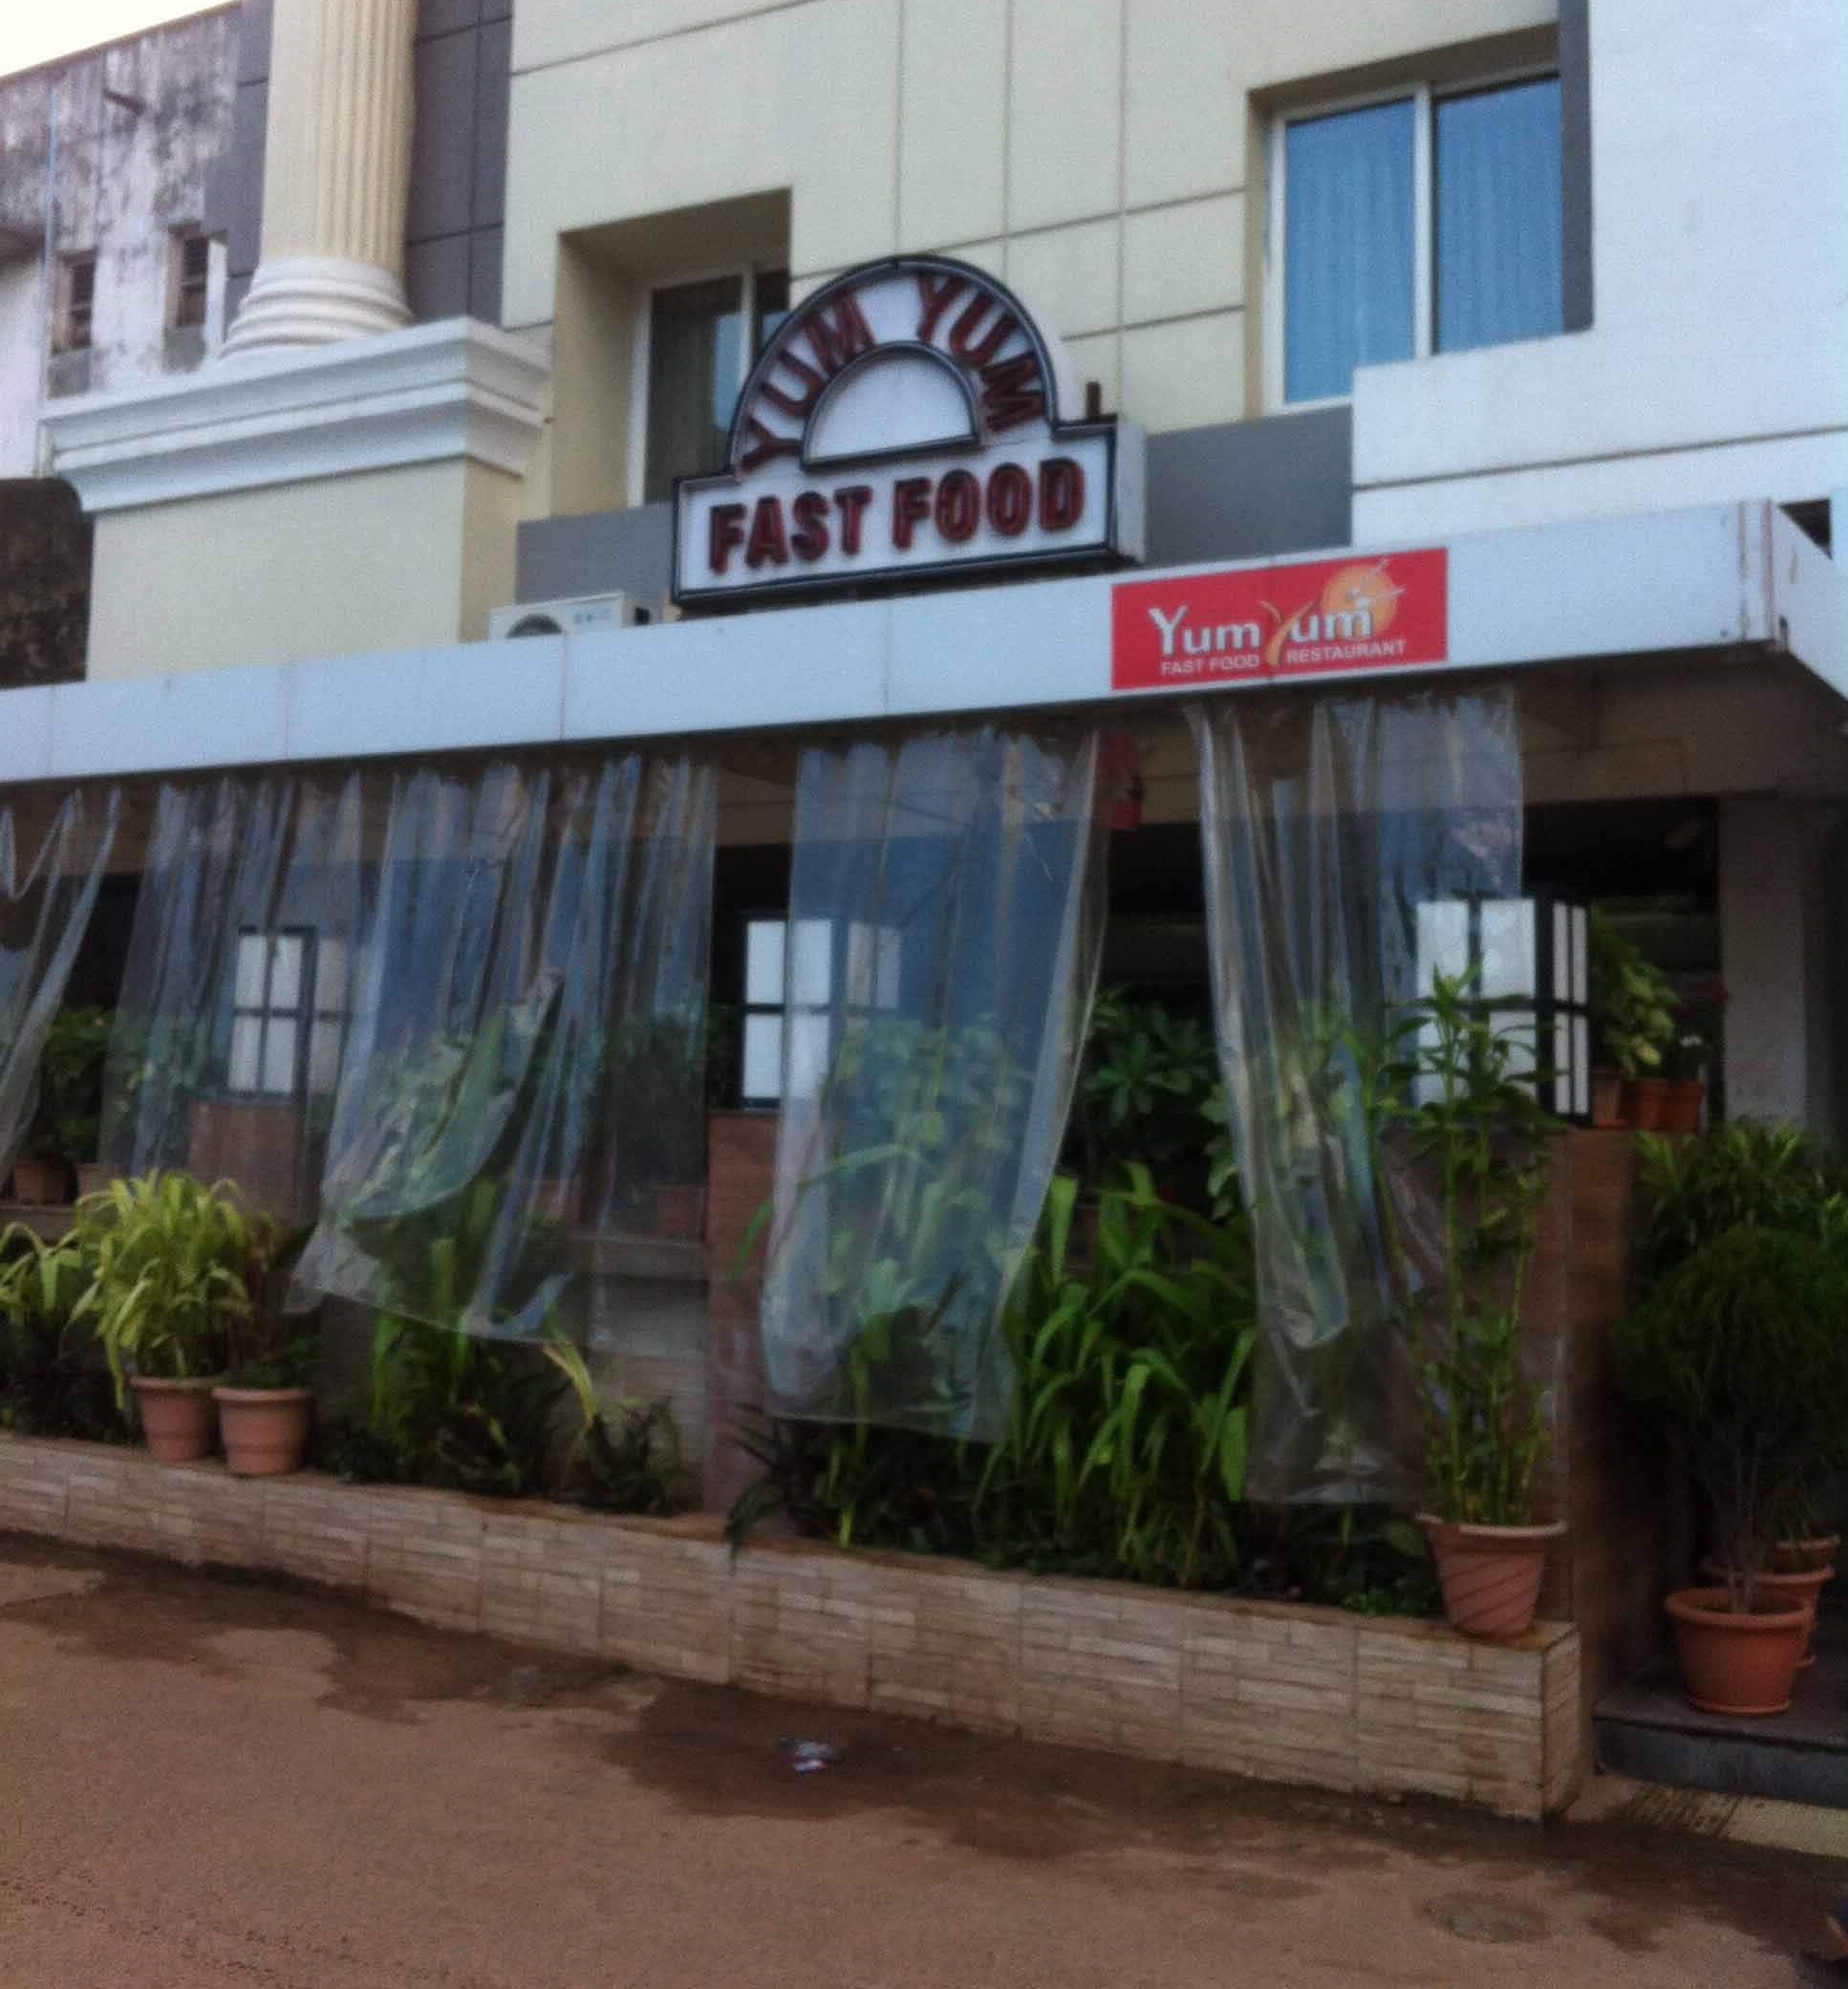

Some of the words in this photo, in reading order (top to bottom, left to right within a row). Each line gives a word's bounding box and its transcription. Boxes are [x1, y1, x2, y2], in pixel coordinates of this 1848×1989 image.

[739, 290, 876, 475] YUM
[914, 271, 1046, 433] YUM
[707, 485, 873, 574] FAST
[892, 457, 1085, 551] FOOD
[1149, 602, 1262, 657] Yum
[1160, 657, 1204, 676] FAST
[1209, 654, 1260, 672] FOOD
[1286, 639, 1407, 664] RESTAURANT
